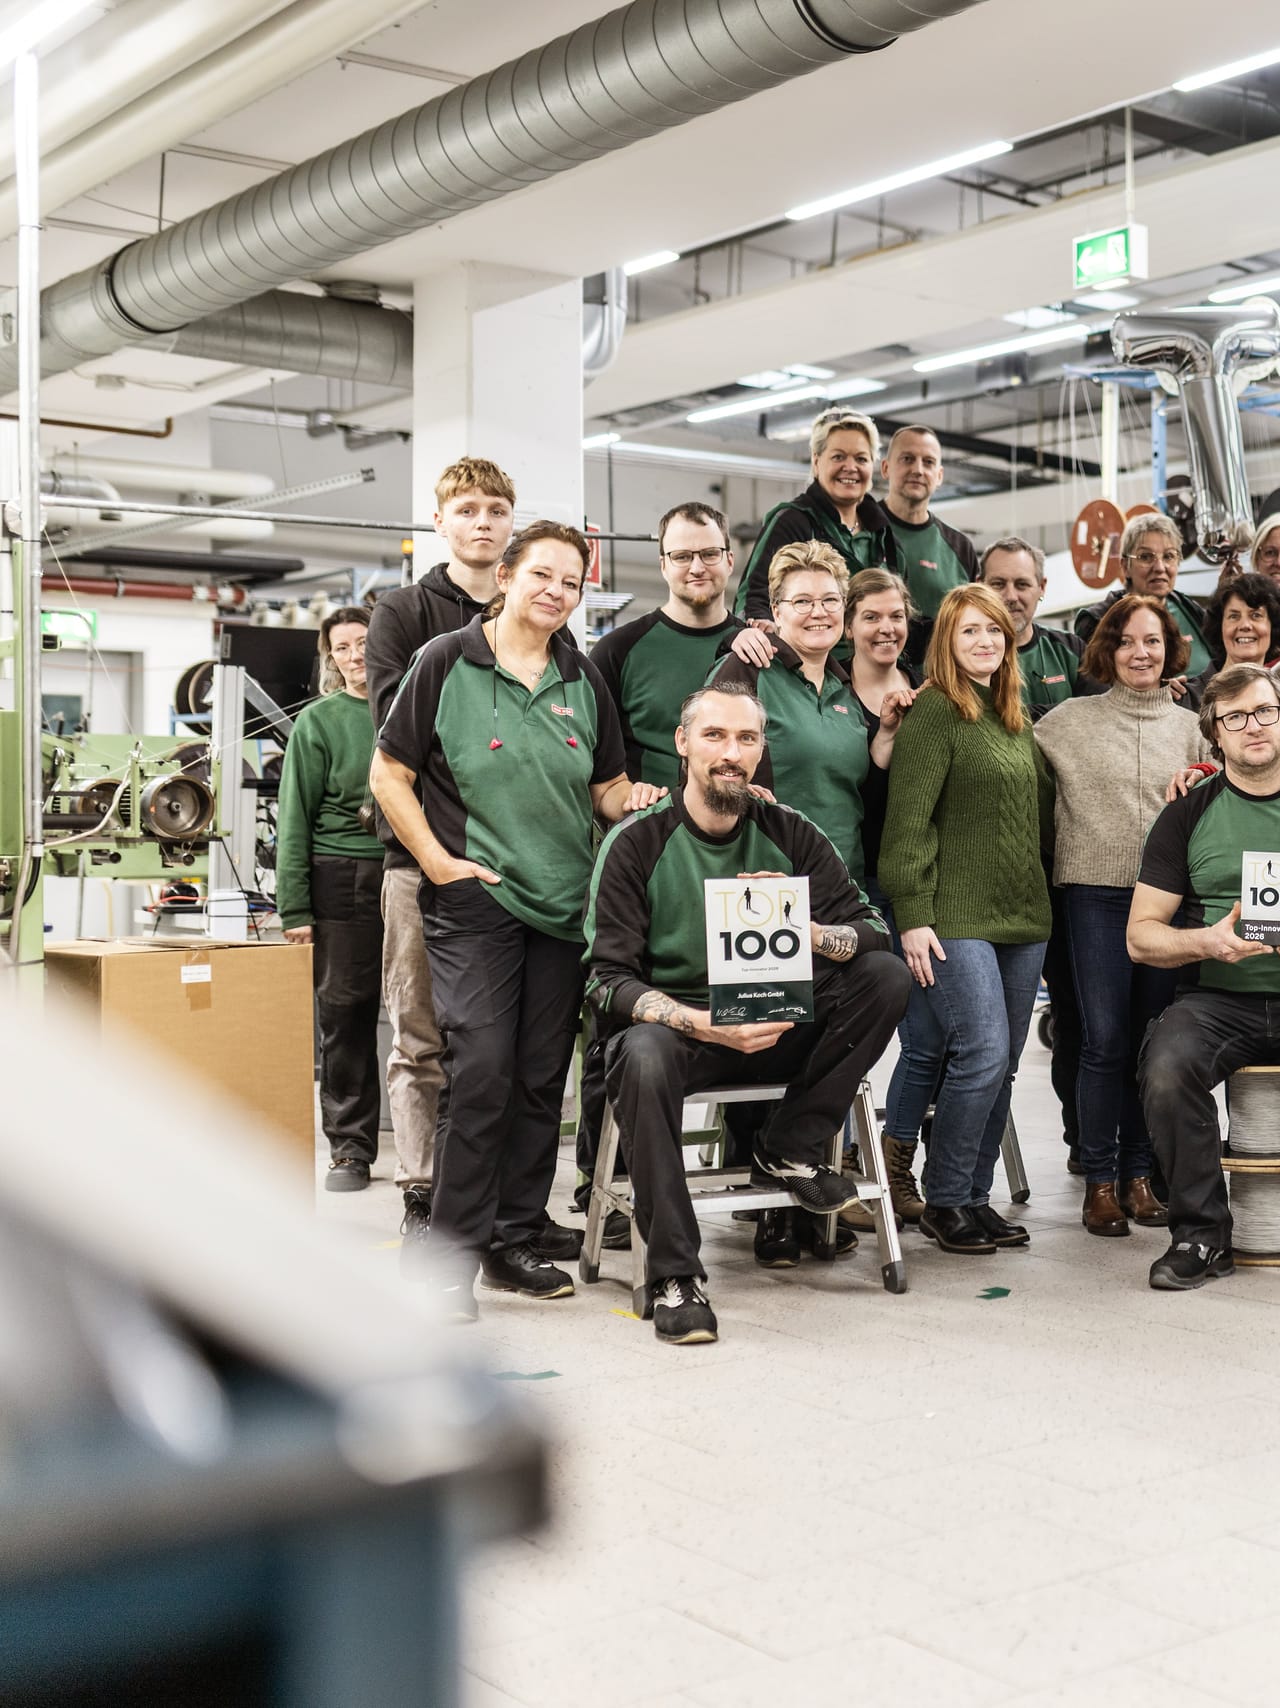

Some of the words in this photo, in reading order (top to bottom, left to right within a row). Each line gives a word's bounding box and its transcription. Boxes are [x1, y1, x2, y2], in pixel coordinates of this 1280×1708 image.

[714, 889, 797, 928] TOP
[719, 929, 800, 961] 100
[1244, 933, 1265, 941] 2026
[737, 992, 753, 1000] Julius
[753, 991, 768, 999] Koch
[767, 990, 785, 998] GmbH
